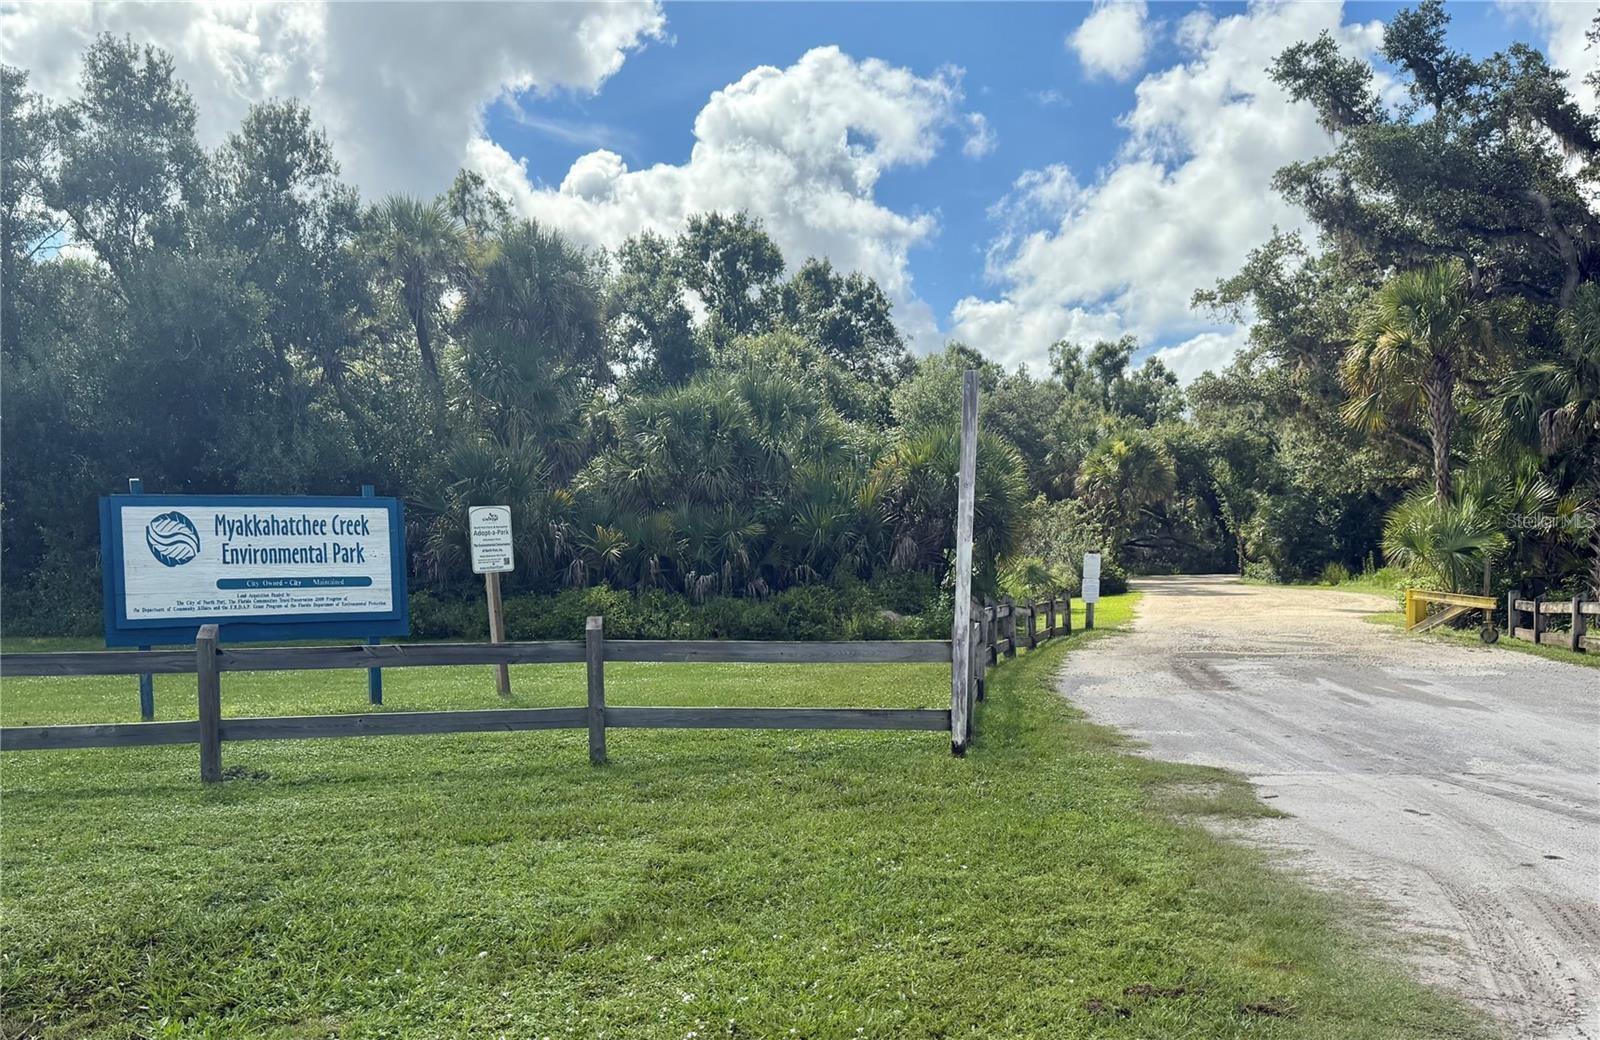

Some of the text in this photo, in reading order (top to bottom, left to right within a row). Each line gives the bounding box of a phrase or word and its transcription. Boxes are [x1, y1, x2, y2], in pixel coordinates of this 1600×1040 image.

[214, 514, 370, 541] Myakkahatchee Creek
[222, 542, 366, 564] Environmental Park
